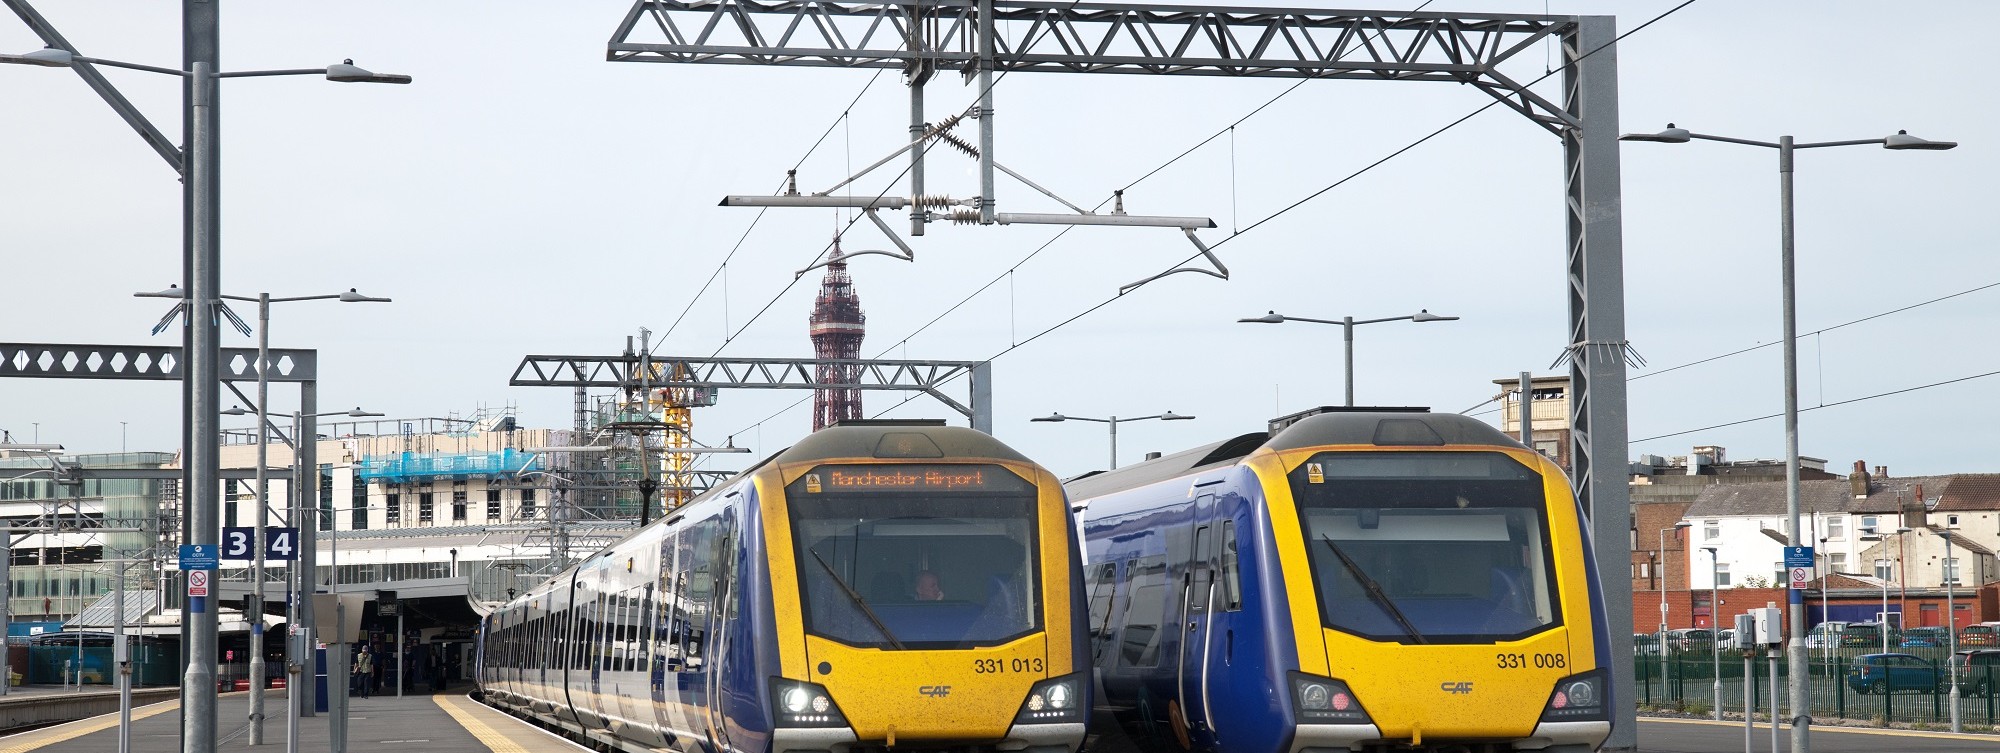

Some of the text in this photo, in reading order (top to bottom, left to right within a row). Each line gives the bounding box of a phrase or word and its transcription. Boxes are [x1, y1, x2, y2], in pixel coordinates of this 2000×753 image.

[831, 471, 983, 488] Manchester Airport
[228, 531, 247, 556] 3
[271, 532, 292, 556] 4
[974, 658, 1044, 674] 331 013
[1496, 653, 1566, 669] 331 008
[918, 685, 952, 698] CAF
[1440, 681, 1474, 695] CAF
